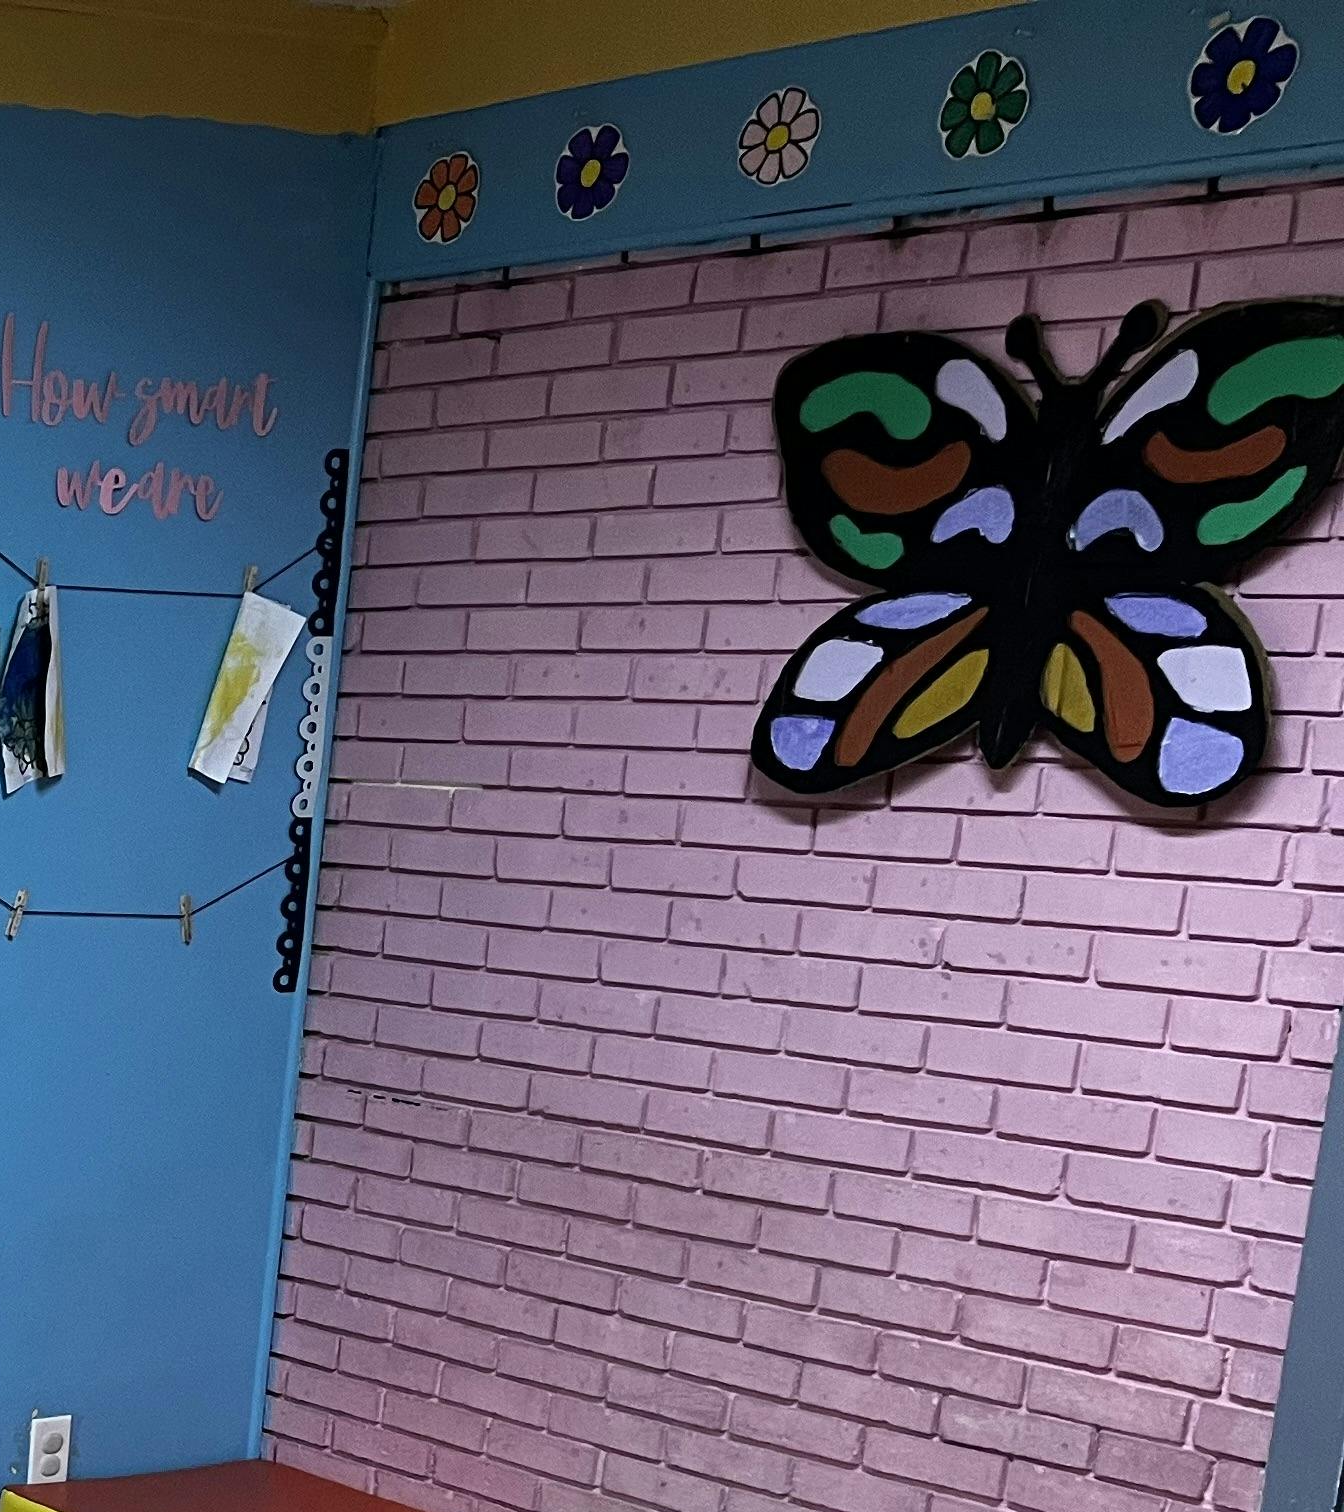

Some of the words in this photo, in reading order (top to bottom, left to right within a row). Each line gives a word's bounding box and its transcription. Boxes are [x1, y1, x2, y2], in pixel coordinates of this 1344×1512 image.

[1, 312, 126, 426] How
[128, 372, 279, 446] smart
[56, 459, 139, 515] we
[137, 461, 224, 521] are
